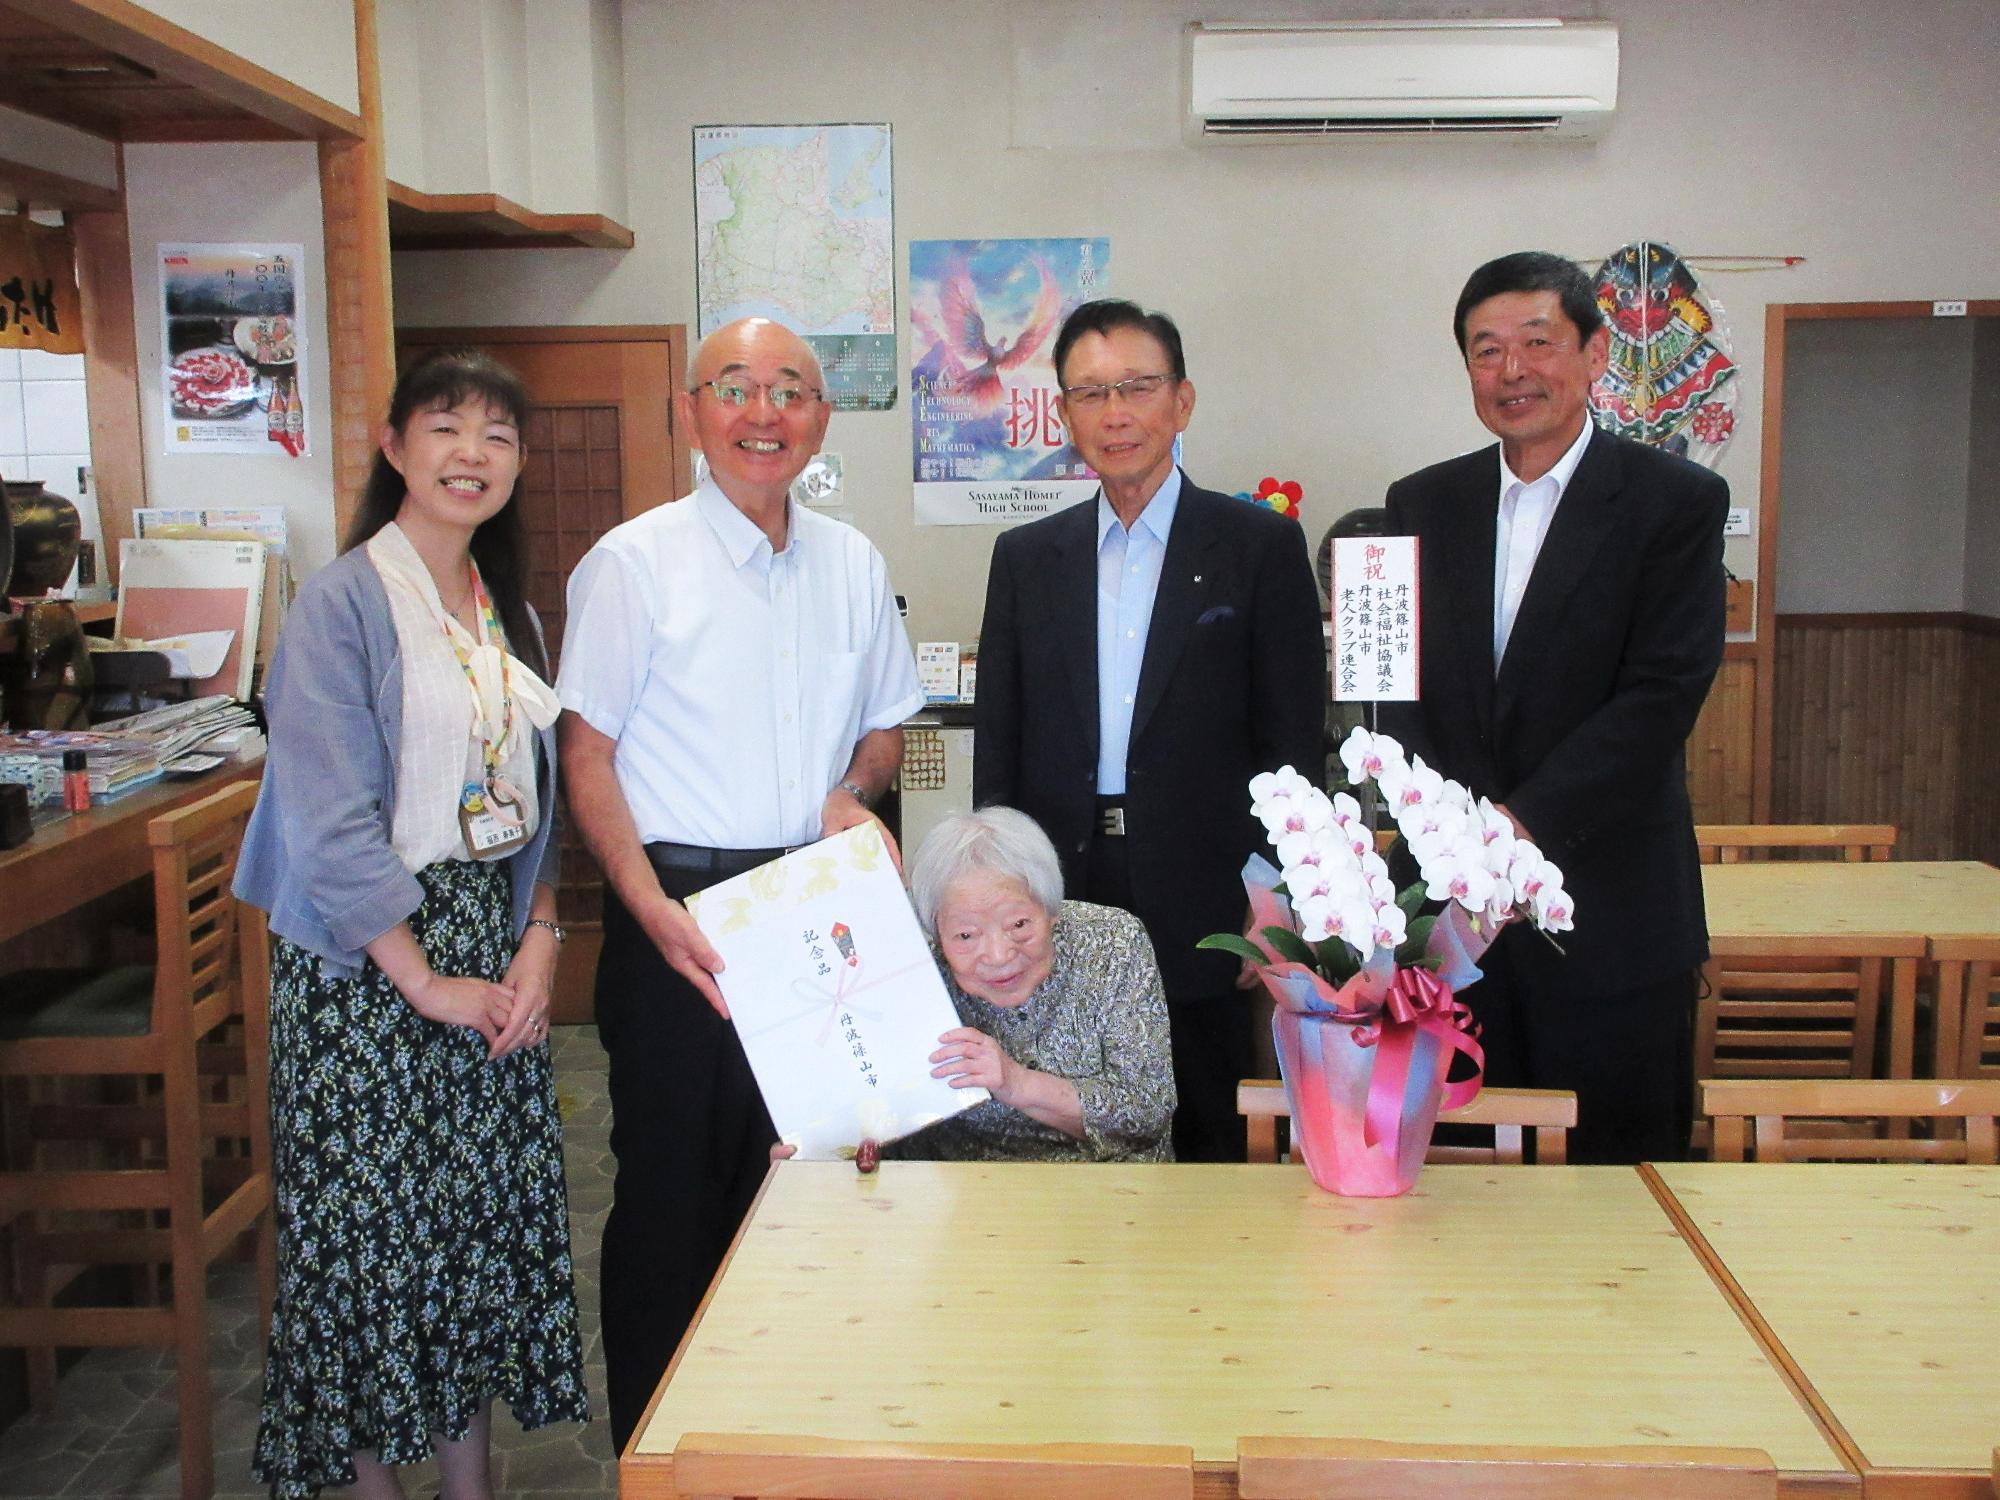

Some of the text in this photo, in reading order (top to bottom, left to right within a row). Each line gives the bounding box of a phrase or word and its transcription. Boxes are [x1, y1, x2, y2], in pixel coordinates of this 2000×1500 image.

[1005, 388, 1063, 448] 挑
[968, 490, 1019, 501] SASAYAMA
[977, 502, 1048, 513] HIGH SCHOOL
[1363, 543, 1386, 581] 御祝
[1358, 584, 1373, 656] 丹波篠山市
[1376, 587, 1393, 693] 社会福祉協議会
[1394, 583, 1409, 656] 丹波篠山市
[803, 929, 831, 976] 記念品
[840, 1012, 878, 1088] 丹波篠山市
